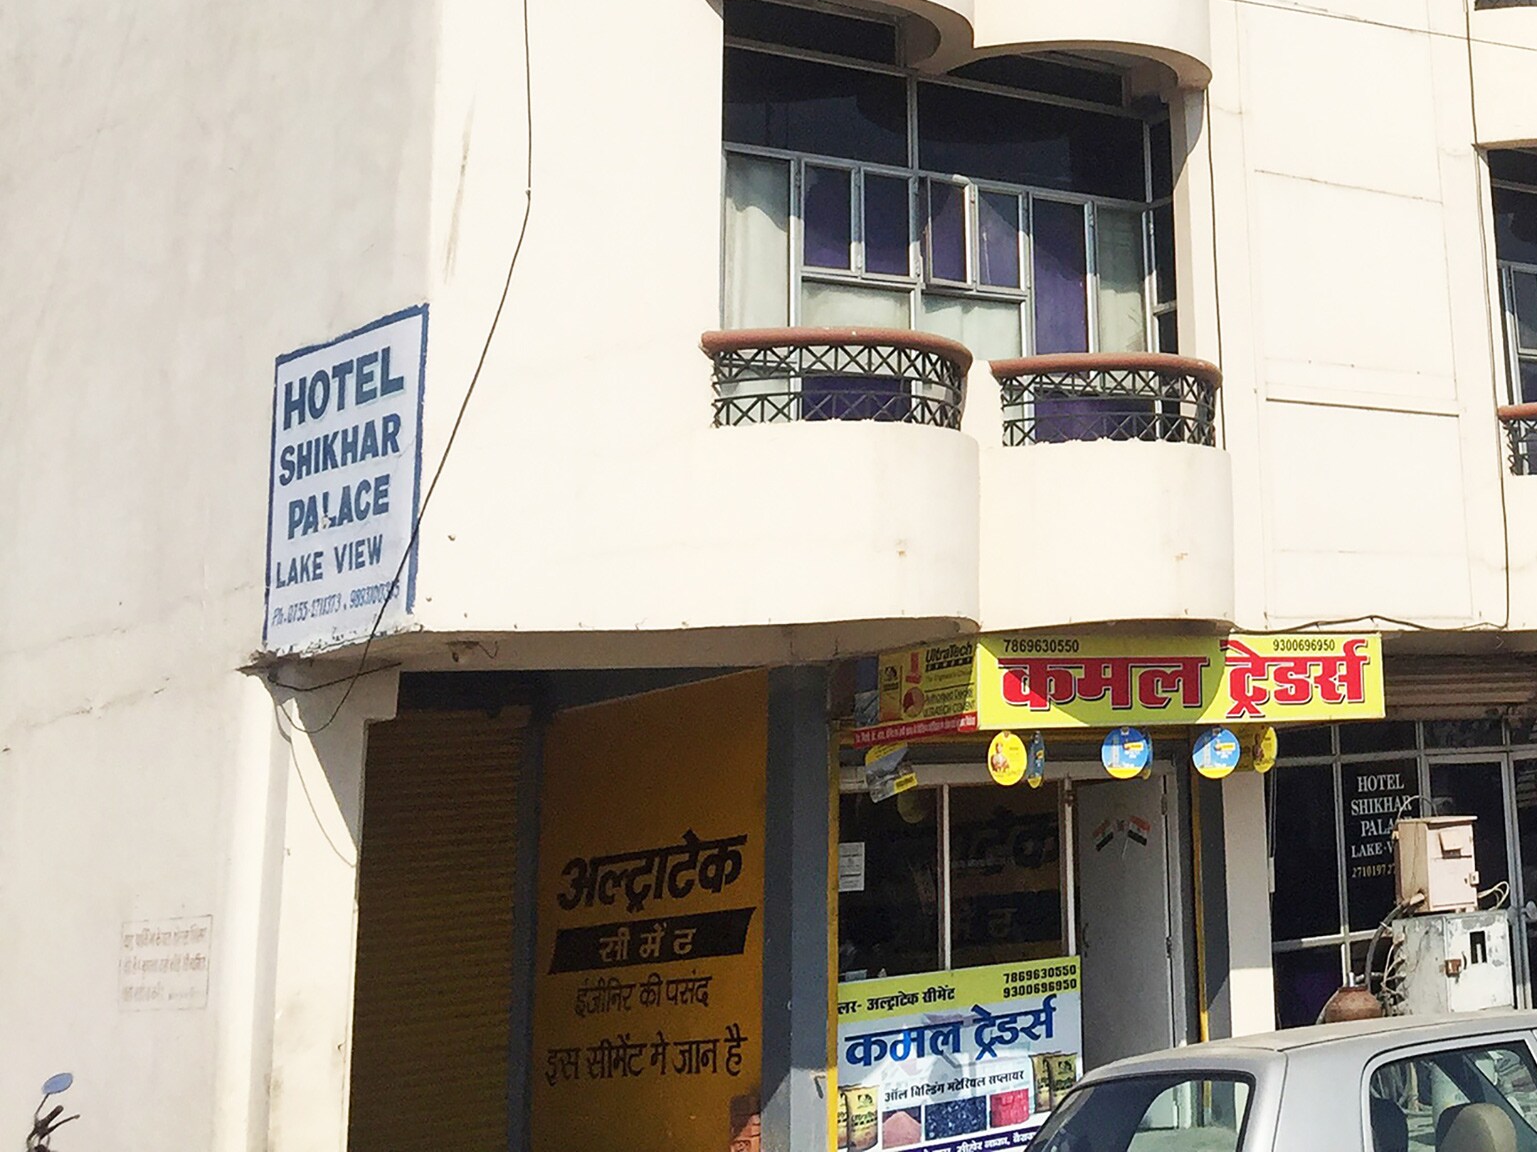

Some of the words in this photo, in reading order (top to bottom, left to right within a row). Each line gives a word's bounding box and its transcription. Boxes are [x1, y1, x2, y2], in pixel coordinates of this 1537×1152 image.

[283, 346, 404, 431] HOTEL
[279, 413, 400, 487] SHIKHAR
[288, 474, 390, 540] PALACE
[276, 551, 324, 589] LAKE
[334, 534, 383, 575] VIEW
[1003, 638, 1080, 654] 7869630550
[1272, 638, 1336, 653] 9300696950
[998, 656, 1209, 711] कमल
[1220, 639, 1370, 718] ट्रेडर्स
[1351, 795, 1412, 816] SHIKHAR
[1357, 773, 1405, 792] HOTEL
[557, 828, 748, 913] अल्ट्राटेक
[639, 972, 664, 1008] की
[665, 969, 713, 1007] पसंद
[1003, 964, 1077, 984] 7869630550
[1003, 978, 1077, 998] 9300696950
[545, 1047, 580, 1087] इस
[673, 1038, 720, 1074] जान
[723, 1023, 748, 1077] है
[845, 1020, 965, 1067] कमल
[971, 994, 1057, 1061] ट्रेडर्स
